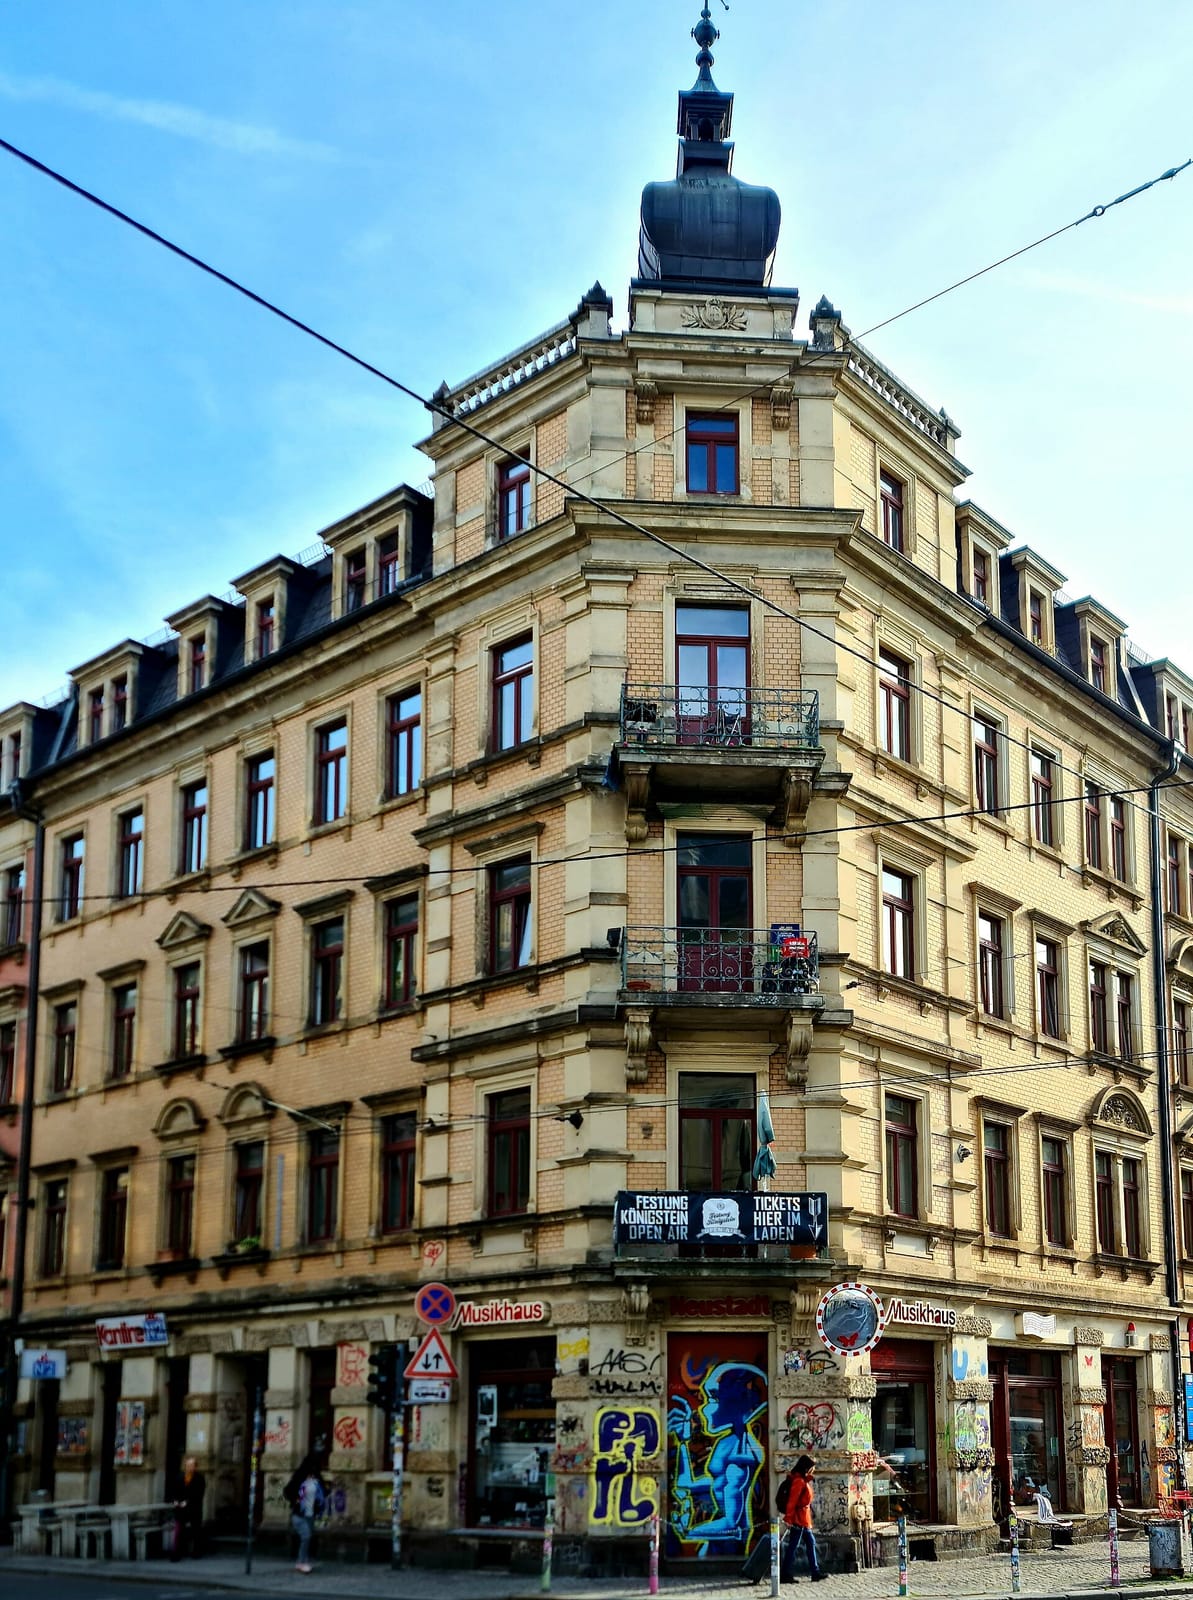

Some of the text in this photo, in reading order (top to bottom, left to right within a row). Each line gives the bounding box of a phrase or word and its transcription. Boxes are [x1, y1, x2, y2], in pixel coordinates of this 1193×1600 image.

[636, 1195, 688, 1210] FESTUNG
[753, 1196, 801, 1211] TICKETS
[620, 1207, 689, 1225] KÖNIGSTEIN
[754, 1211, 801, 1226] HIER IM
[629, 1225, 688, 1241] OPEN AIR
[754, 1226, 794, 1241] LADEN
[452, 1299, 542, 1328] Musikhaus
[670, 1295, 769, 1316] Neustadt
[886, 1299, 956, 1327] Musikhaus
